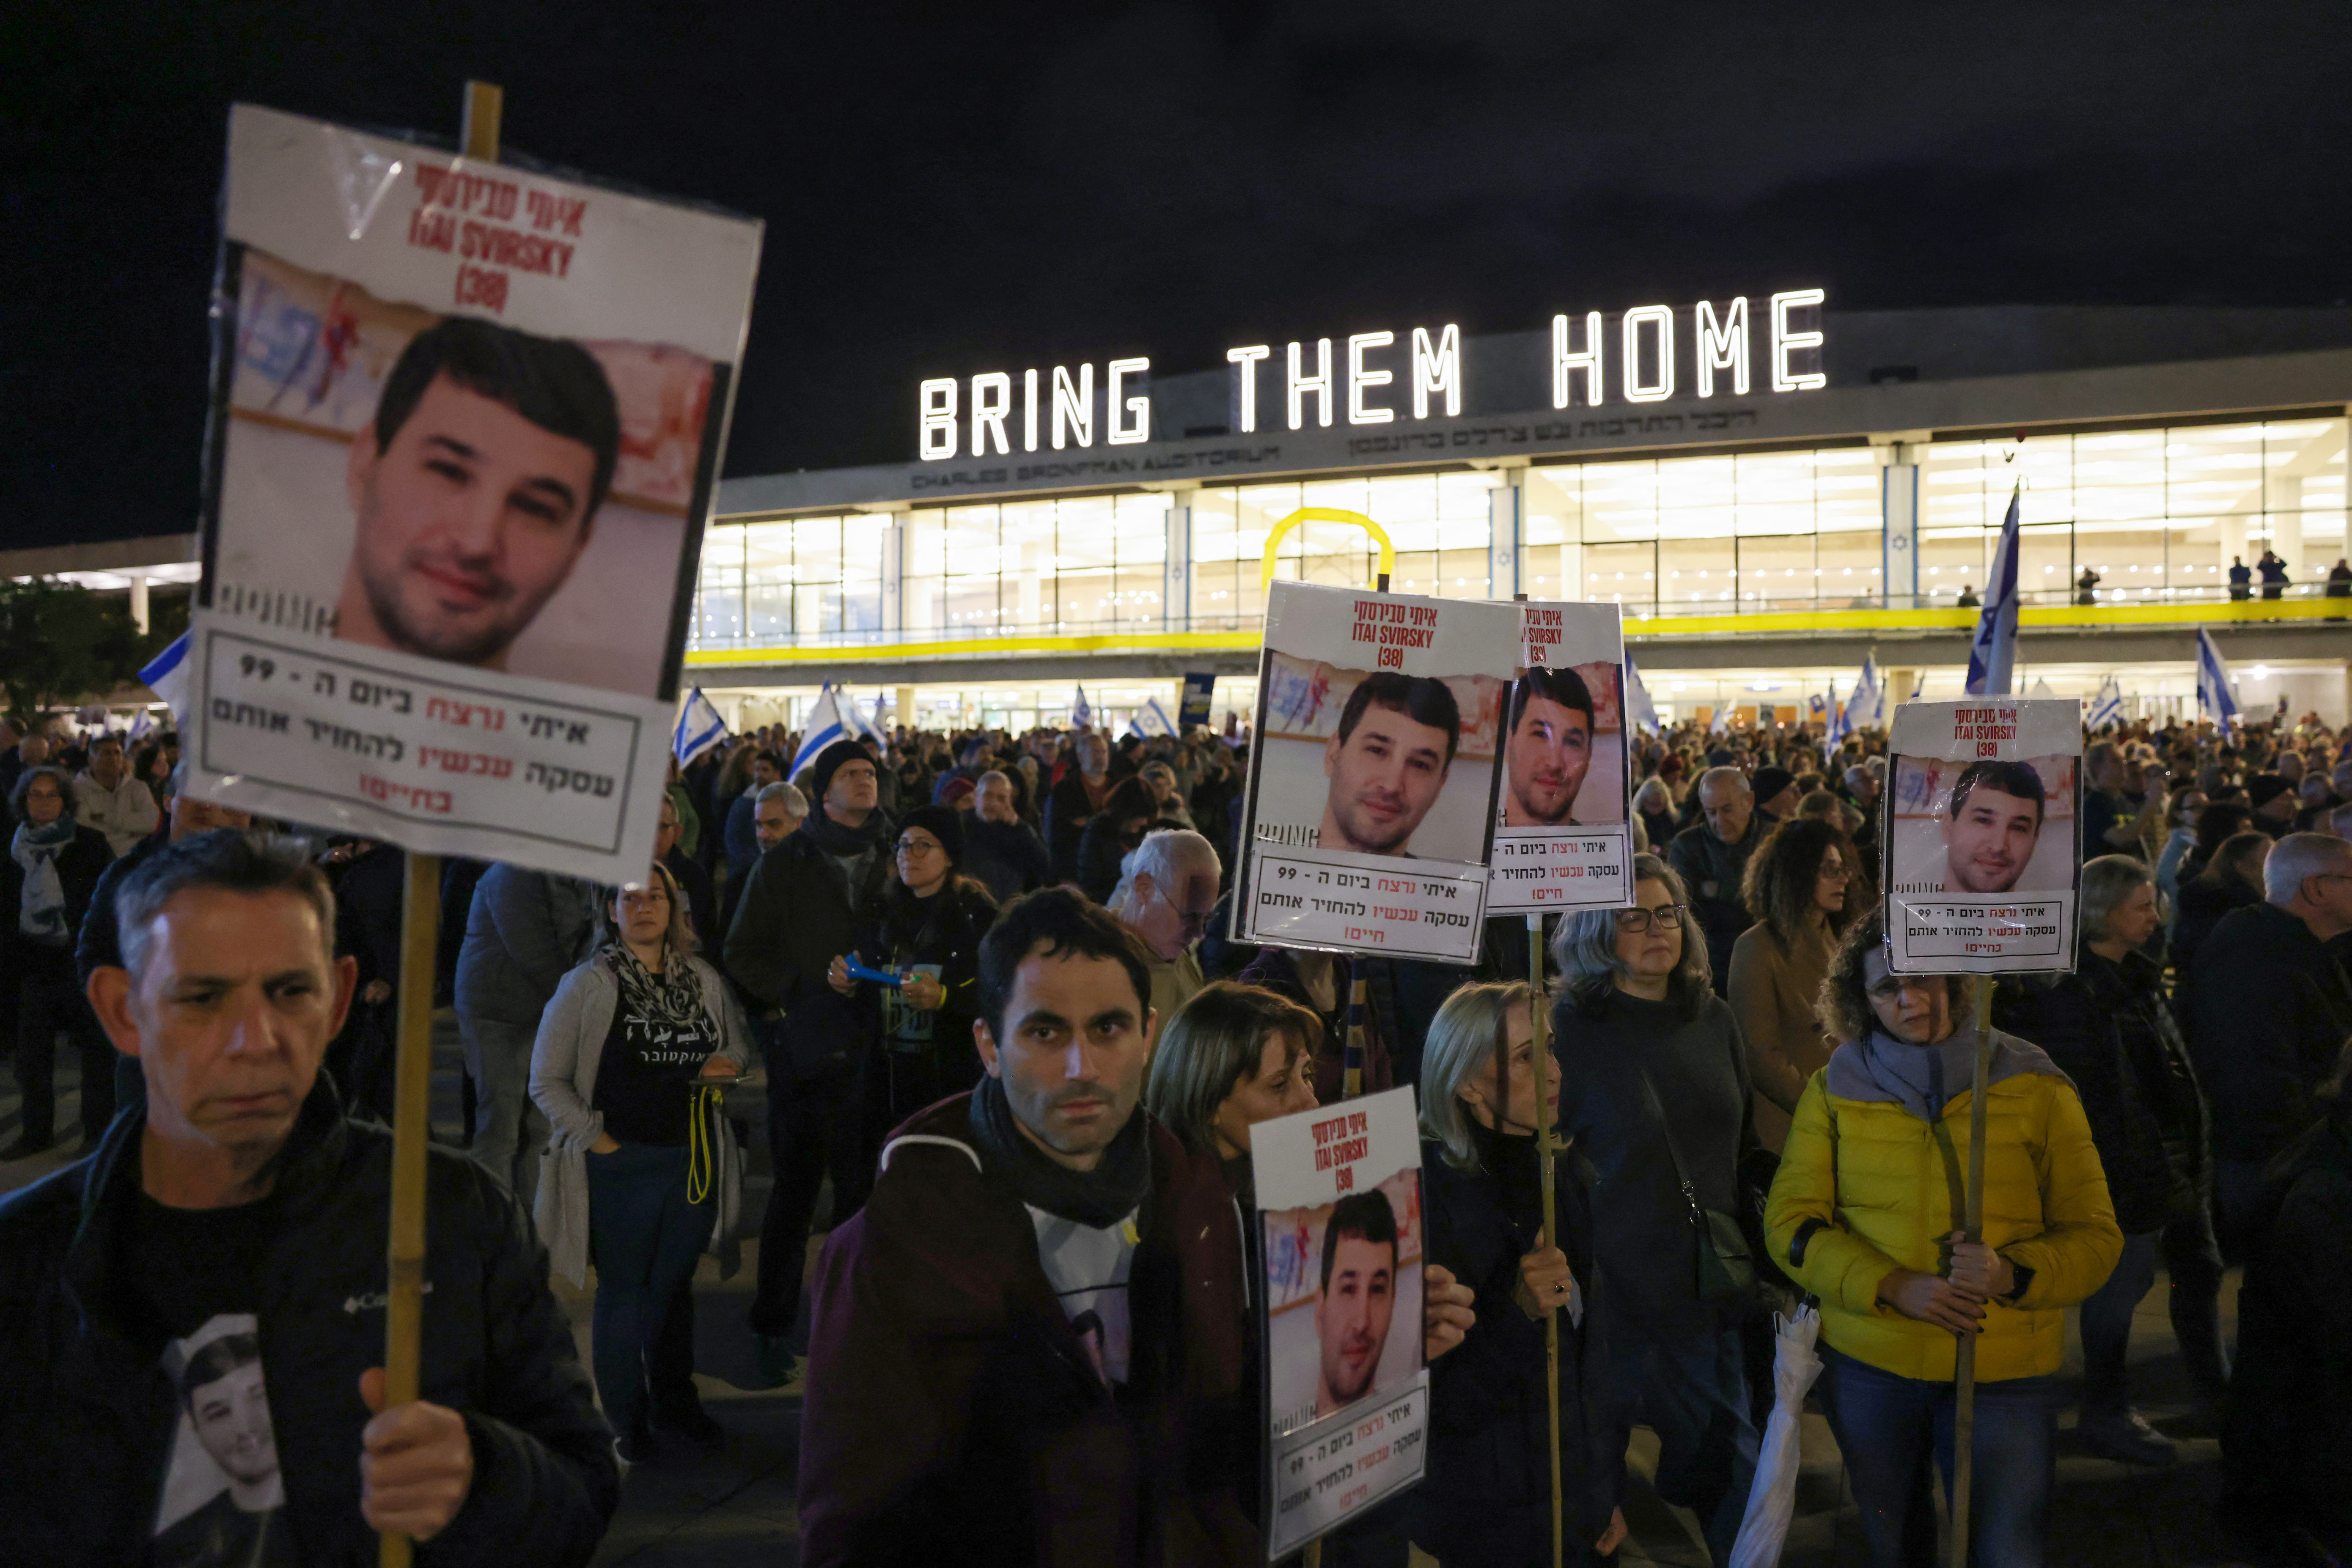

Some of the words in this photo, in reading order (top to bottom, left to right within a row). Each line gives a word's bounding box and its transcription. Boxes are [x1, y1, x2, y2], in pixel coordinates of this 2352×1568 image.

[459, 220, 576, 280] SVIRSKY
[920, 357, 1150, 461] BRING
[1227, 324, 1460, 432] THEM
[1553, 288, 1826, 409] HOME
[1143, 446, 1280, 470] AUDITORIUM
[1354, 600, 1406, 623] סבירסקי
[1410, 606, 1437, 627] איתי
[1542, 610, 1563, 626] איתי
[1352, 622, 1377, 642] ITAI
[1379, 625, 1434, 648] SVIRSKY
[1529, 627, 1561, 644] SVIRSKY
[1378, 646, 1403, 669] (38)
[239, 654, 275, 681] 99
[315, 671, 335, 697] ה
[350, 678, 413, 714] ביום
[212, 697, 290, 731] אותם
[426, 694, 505, 731] נרצח
[1955, 709, 1996, 725] סבירסקי
[1999, 709, 2017, 723] איתי
[518, 711, 590, 745] איתי
[1955, 726, 1973, 739] ITAI
[1976, 725, 2016, 739] SVIRSKY
[304, 717, 404, 761] להחזיר
[1977, 741, 1998, 758] (38)
[418, 745, 512, 779] עכשיו
[525, 761, 613, 797] עסקה
[1505, 844, 1514, 855] ה
[1520, 843, 1547, 855] ביום
[1552, 843, 1578, 854] נרצח
[1583, 842, 1606, 853] איתי
[1278, 867, 1297, 880] 99
[1318, 871, 1329, 884] ה
[1502, 866, 1545, 879] להחזיר
[1551, 867, 1583, 878] עכשיו
[1588, 865, 1619, 879] עסקה
[1337, 873, 1370, 889] ביום
[1378, 877, 1416, 894] נרצח
[1423, 882, 1457, 898] איתי
[1533, 888, 1562, 900] חיים!
[1261, 892, 1303, 909] אותם
[1311, 897, 1366, 917] להחזיר
[1373, 905, 1418, 922] עכשיו
[1424, 911, 1470, 928] עסקה
[1918, 909, 1931, 917] 99
[1947, 909, 1954, 917] ה
[1960, 909, 1984, 917] ביום
[1990, 908, 2017, 917] נרצח
[2021, 907, 2045, 917] איתי
[1344, 926, 1385, 943] חיים!
[1909, 928, 1937, 936] אותם
[1943, 927, 1983, 936] להחזיר
[1989, 927, 2021, 936] עכשיו
[2026, 926, 2055, 936] עסקה
[1965, 944, 2001, 952] בחיים!
[1315, 1147, 1332, 1172] ITAI
[1333, 1136, 1368, 1166] SVIRSKY
[1388, 1403, 1410, 1424] איתי
[1357, 1416, 1384, 1441] נרצח
[1331, 1432, 1353, 1454] ביום
[1318, 1445, 1326, 1461] ה
